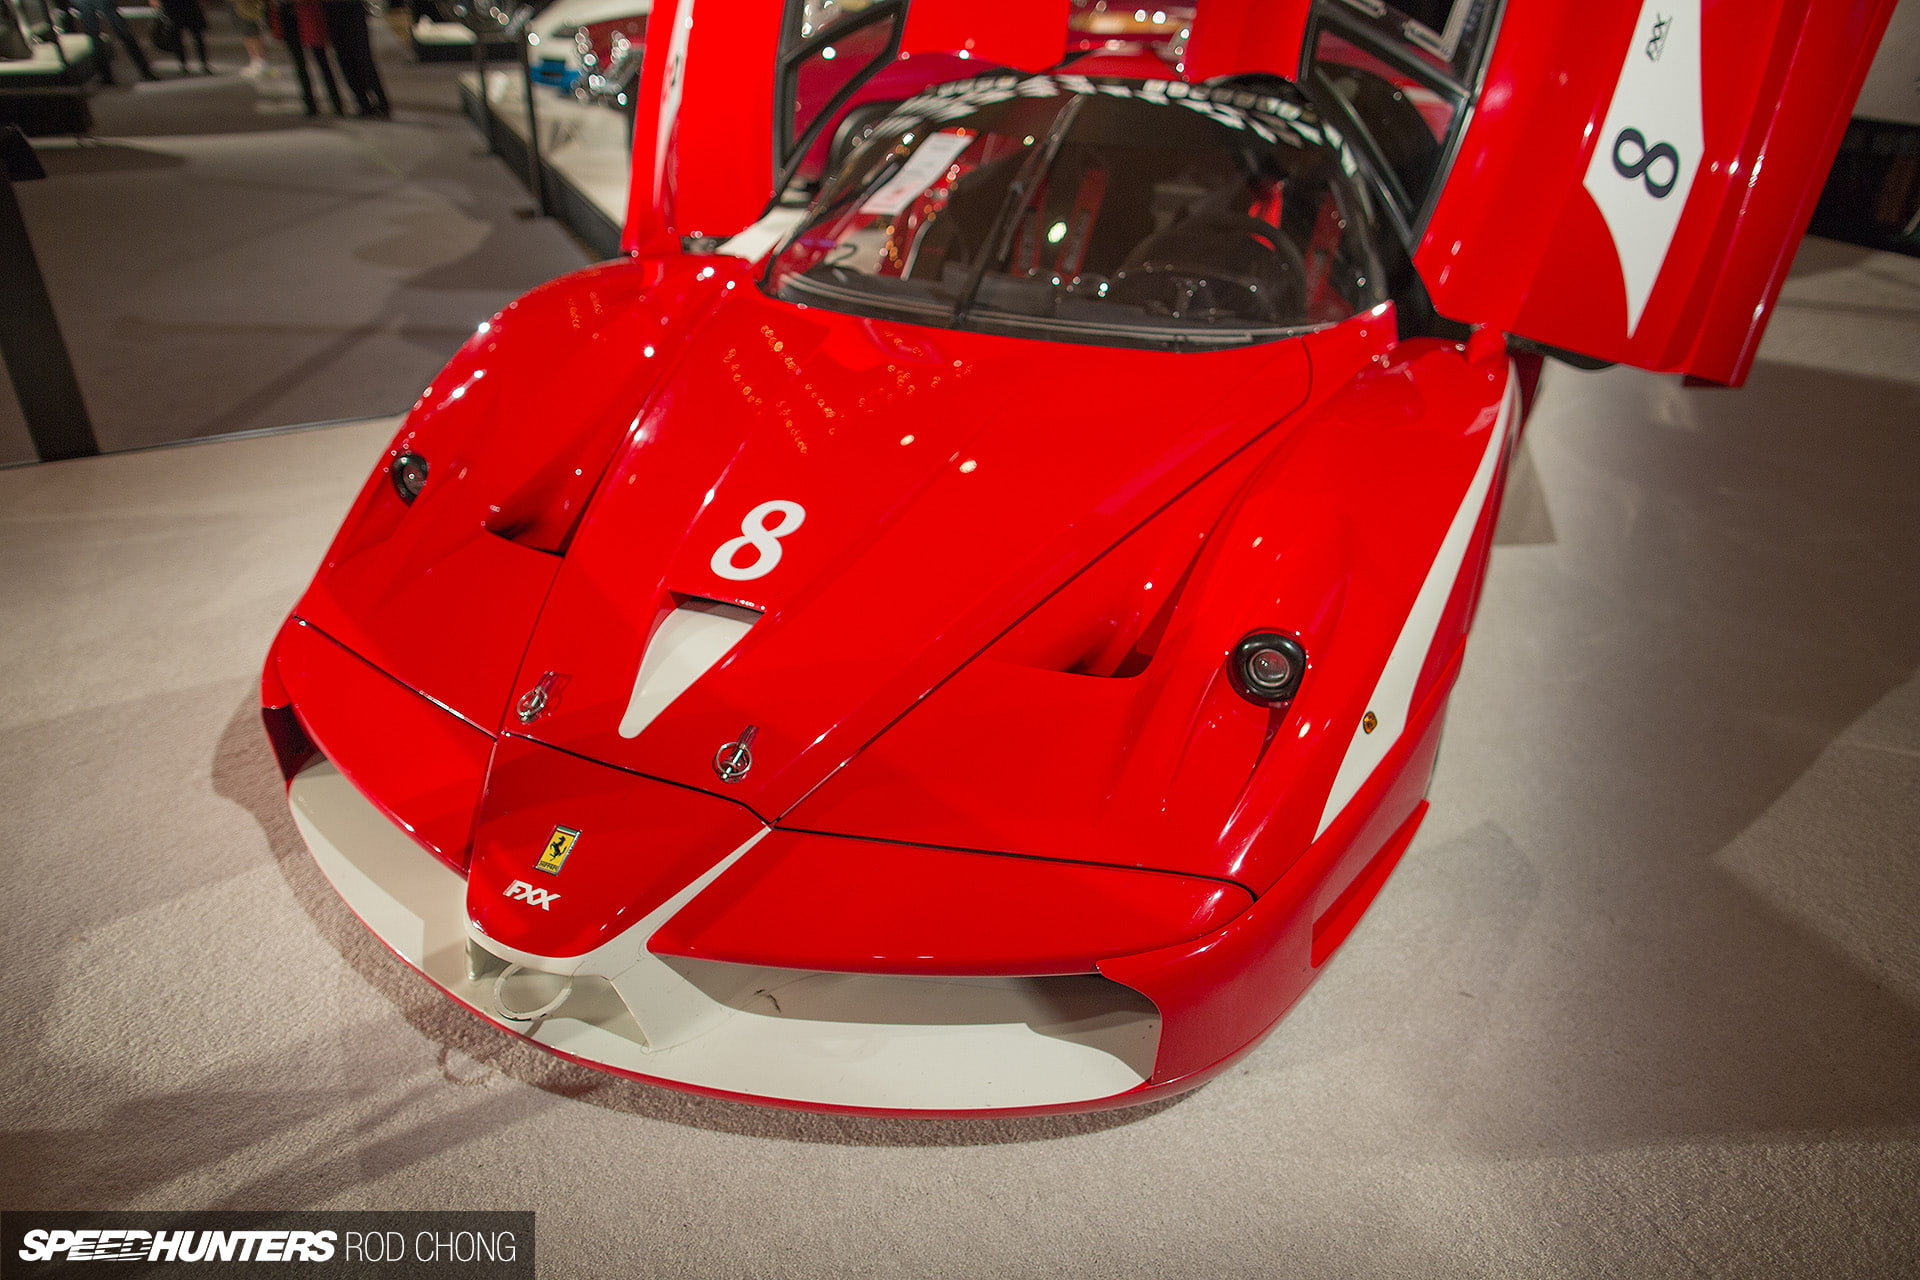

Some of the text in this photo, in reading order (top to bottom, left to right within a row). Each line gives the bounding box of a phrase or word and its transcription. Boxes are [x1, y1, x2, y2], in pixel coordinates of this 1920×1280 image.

[1613, 127, 1680, 199] 8
[710, 499, 806, 581] 8
[502, 879, 561, 912] FXX
